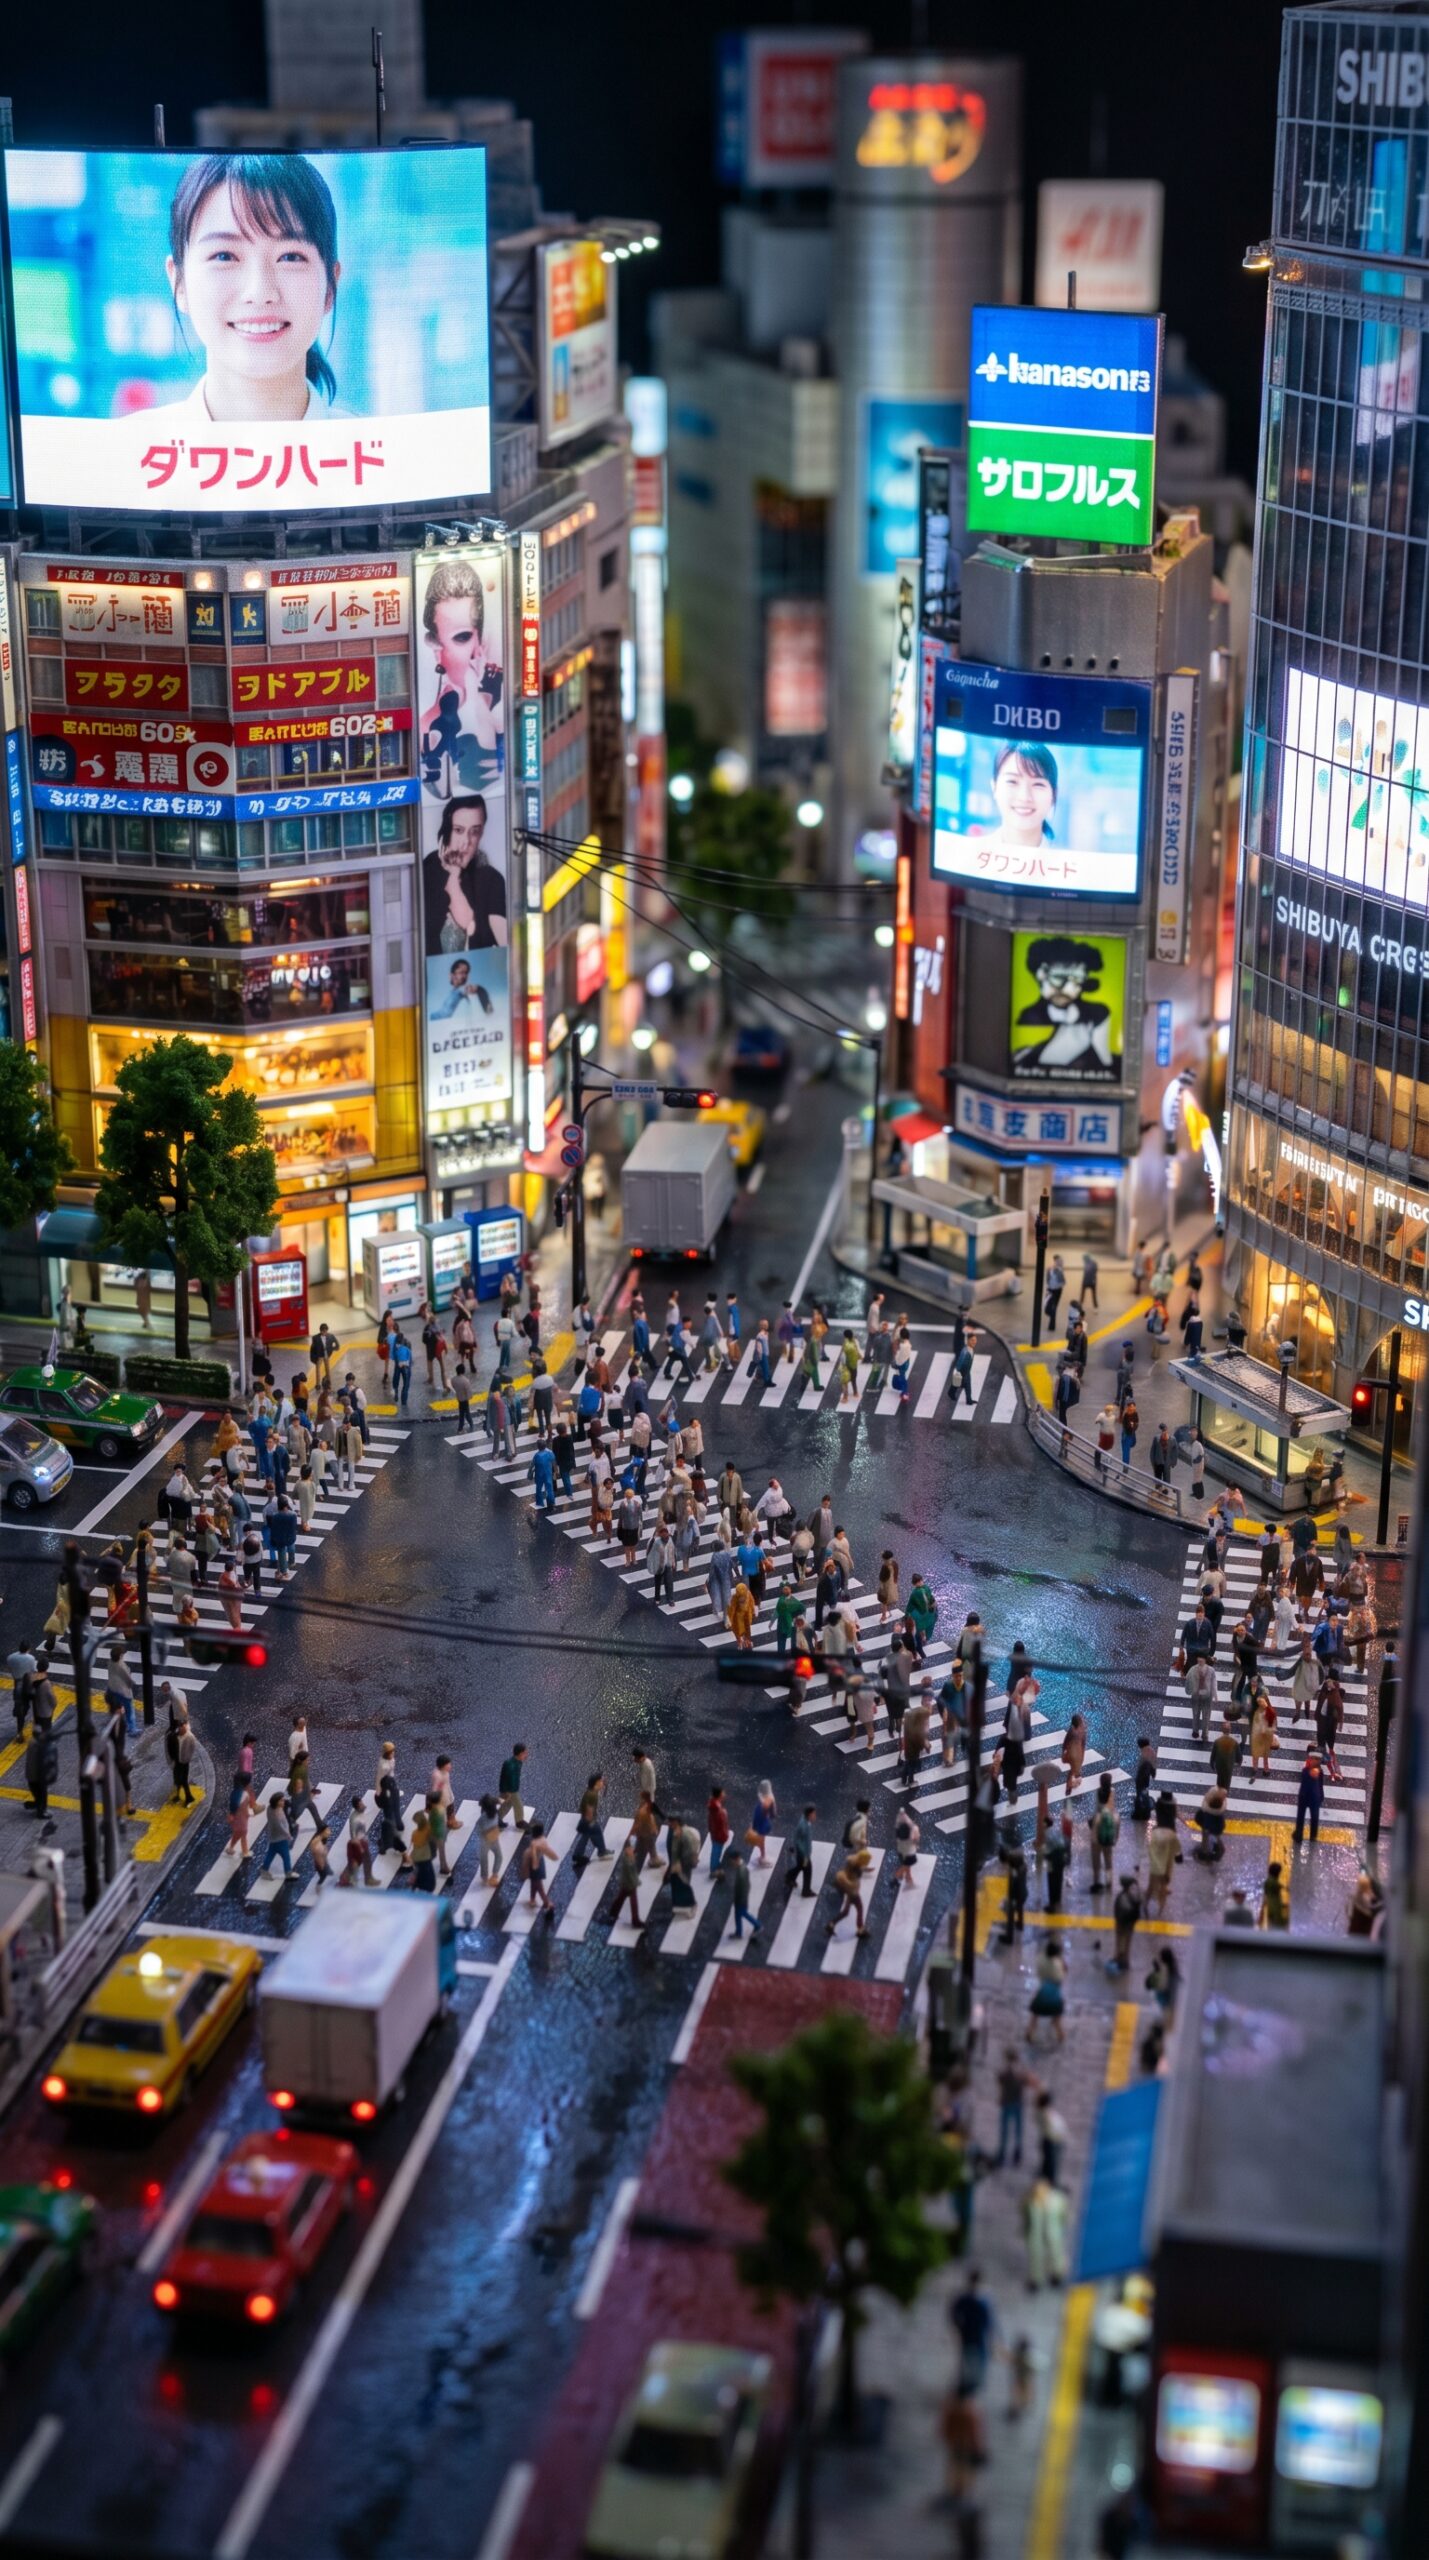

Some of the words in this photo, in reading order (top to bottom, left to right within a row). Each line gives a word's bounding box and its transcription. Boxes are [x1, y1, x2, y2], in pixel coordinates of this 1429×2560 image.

[1336, 48, 1429, 108] SHIB
[140, 439, 385, 490] ダワンハード
[977, 456, 1141, 510] サロフルス
[977, 851, 1078, 879] ダワンハード
[1275, 895, 1363, 957] SHIBUYA
